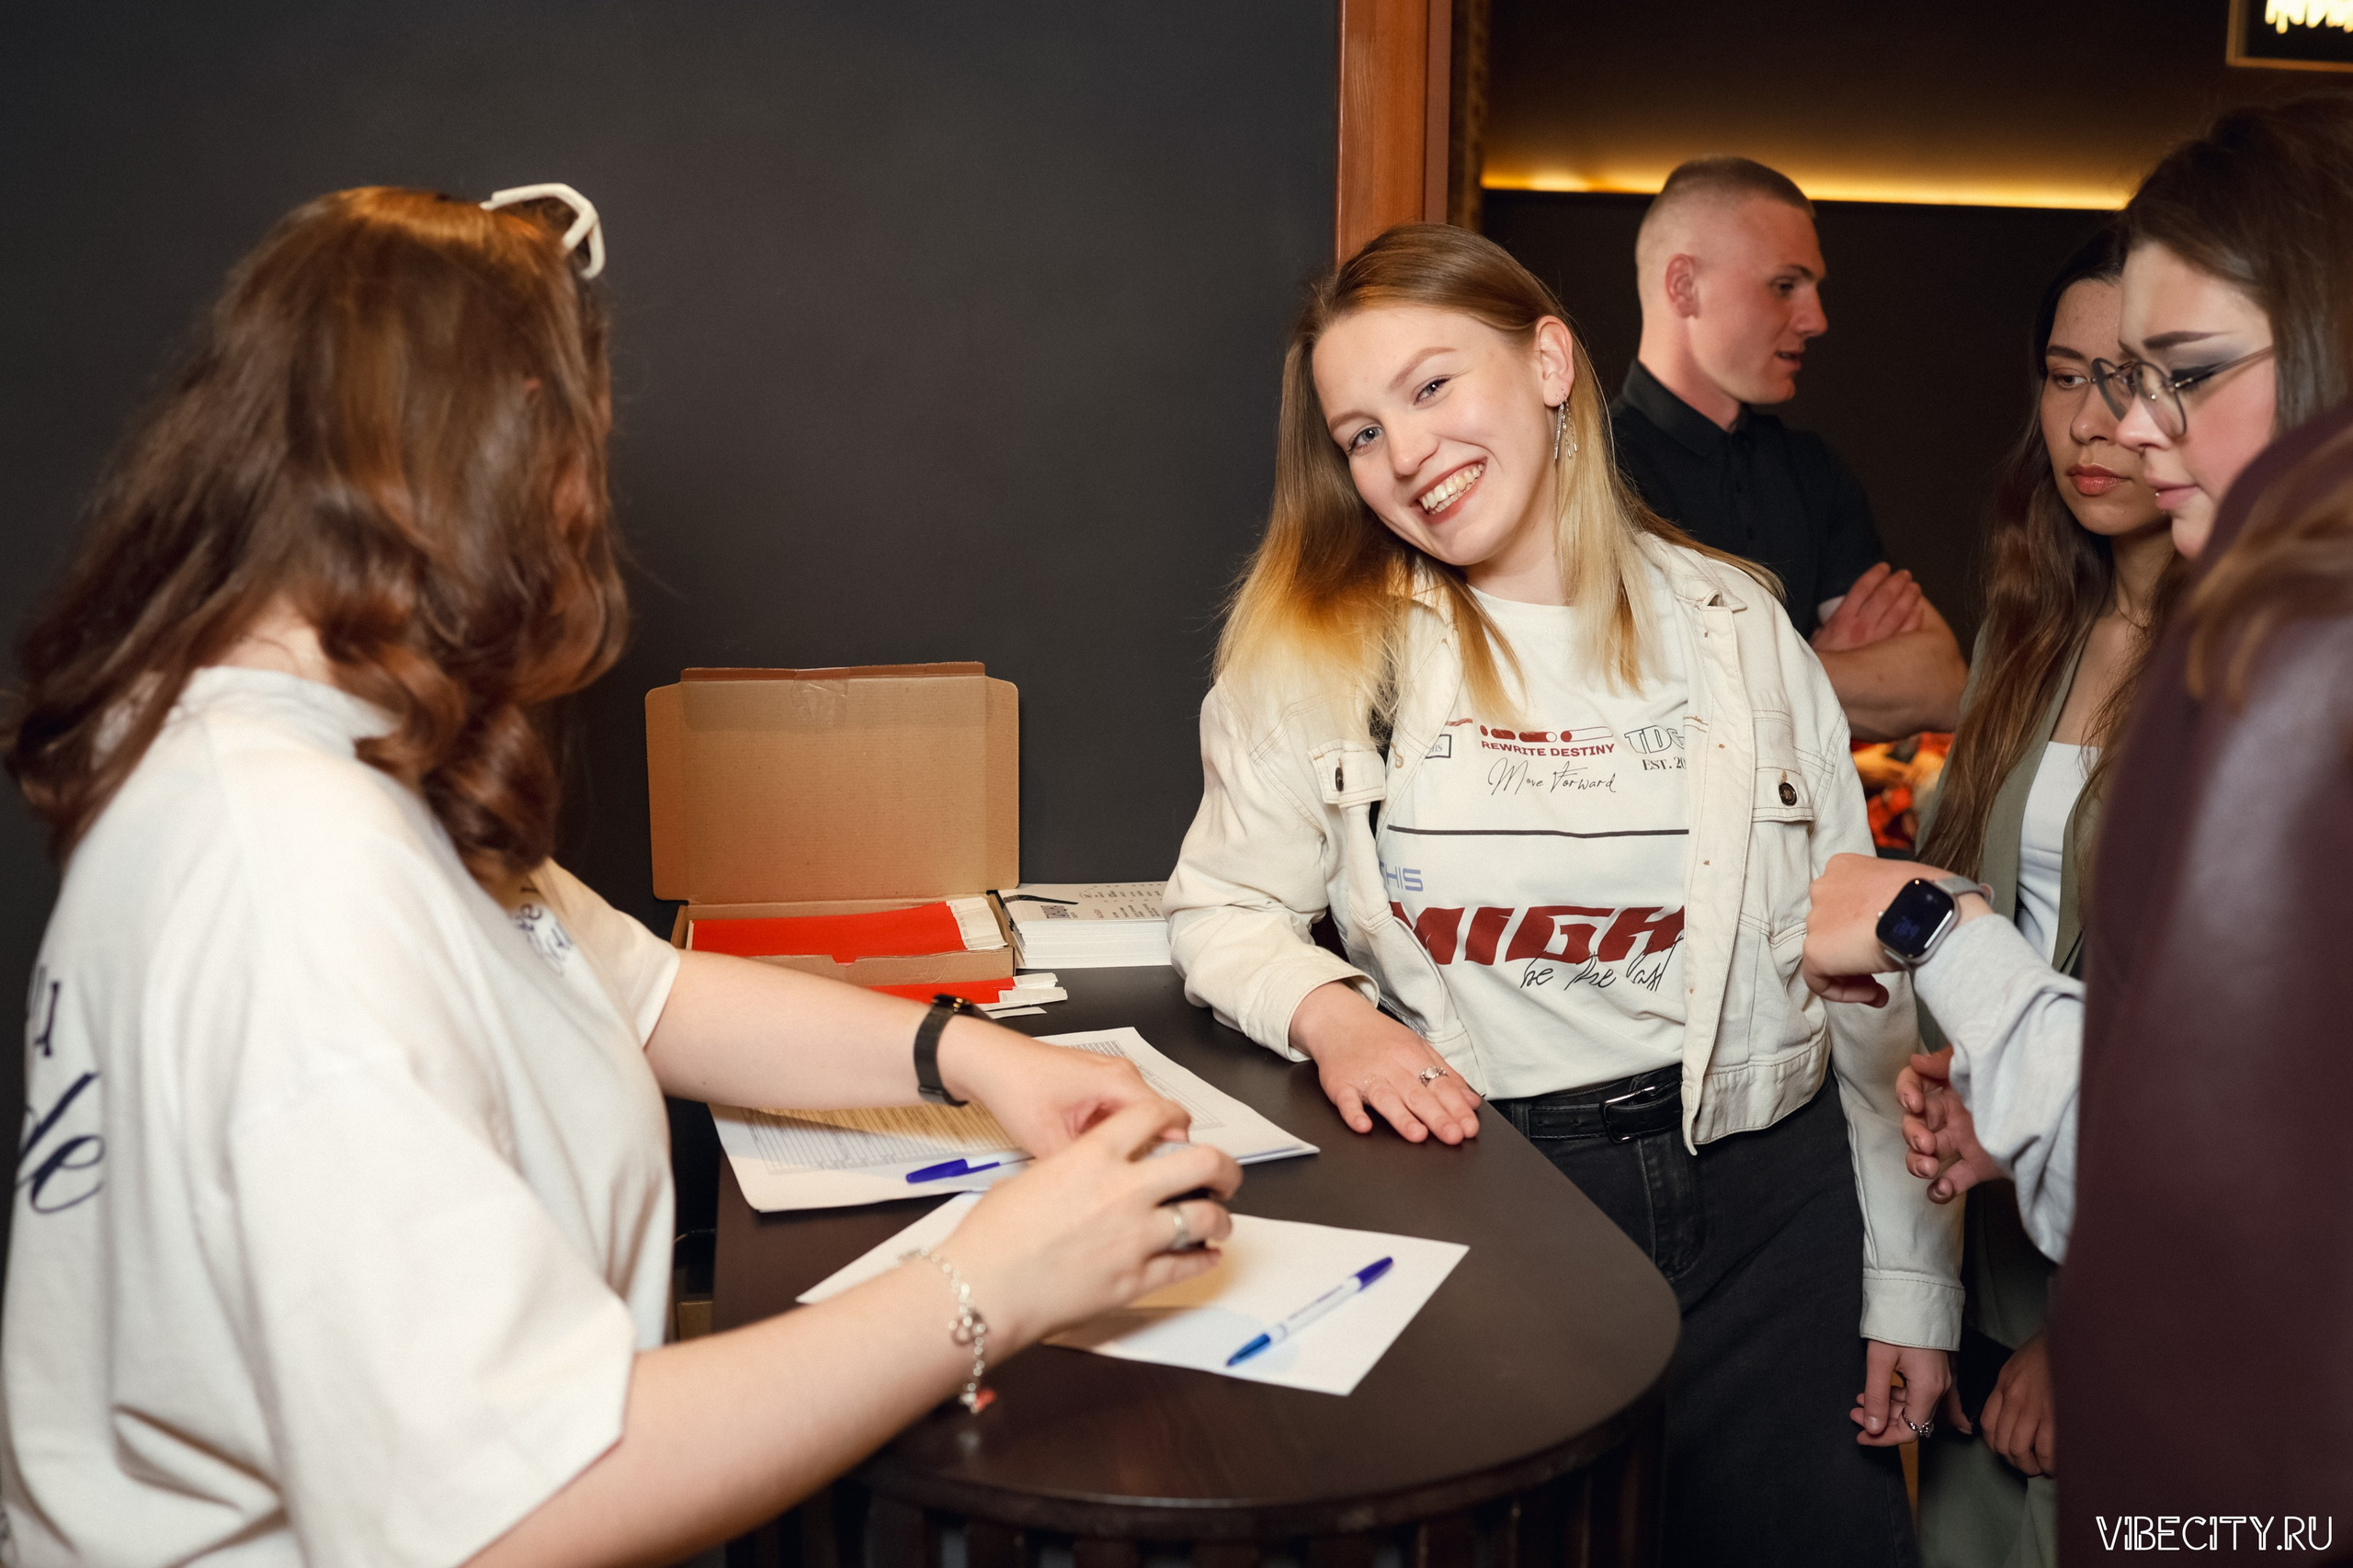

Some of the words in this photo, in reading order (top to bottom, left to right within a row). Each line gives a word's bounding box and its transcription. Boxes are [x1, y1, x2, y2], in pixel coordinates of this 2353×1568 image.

[1481, 740, 1546, 756] REWRITE
[1550, 743, 1615, 757] DESTINY
[1642, 758, 1672, 771] EST.
[1487, 756, 1544, 796] Move
[1550, 760, 1617, 793] Forward
